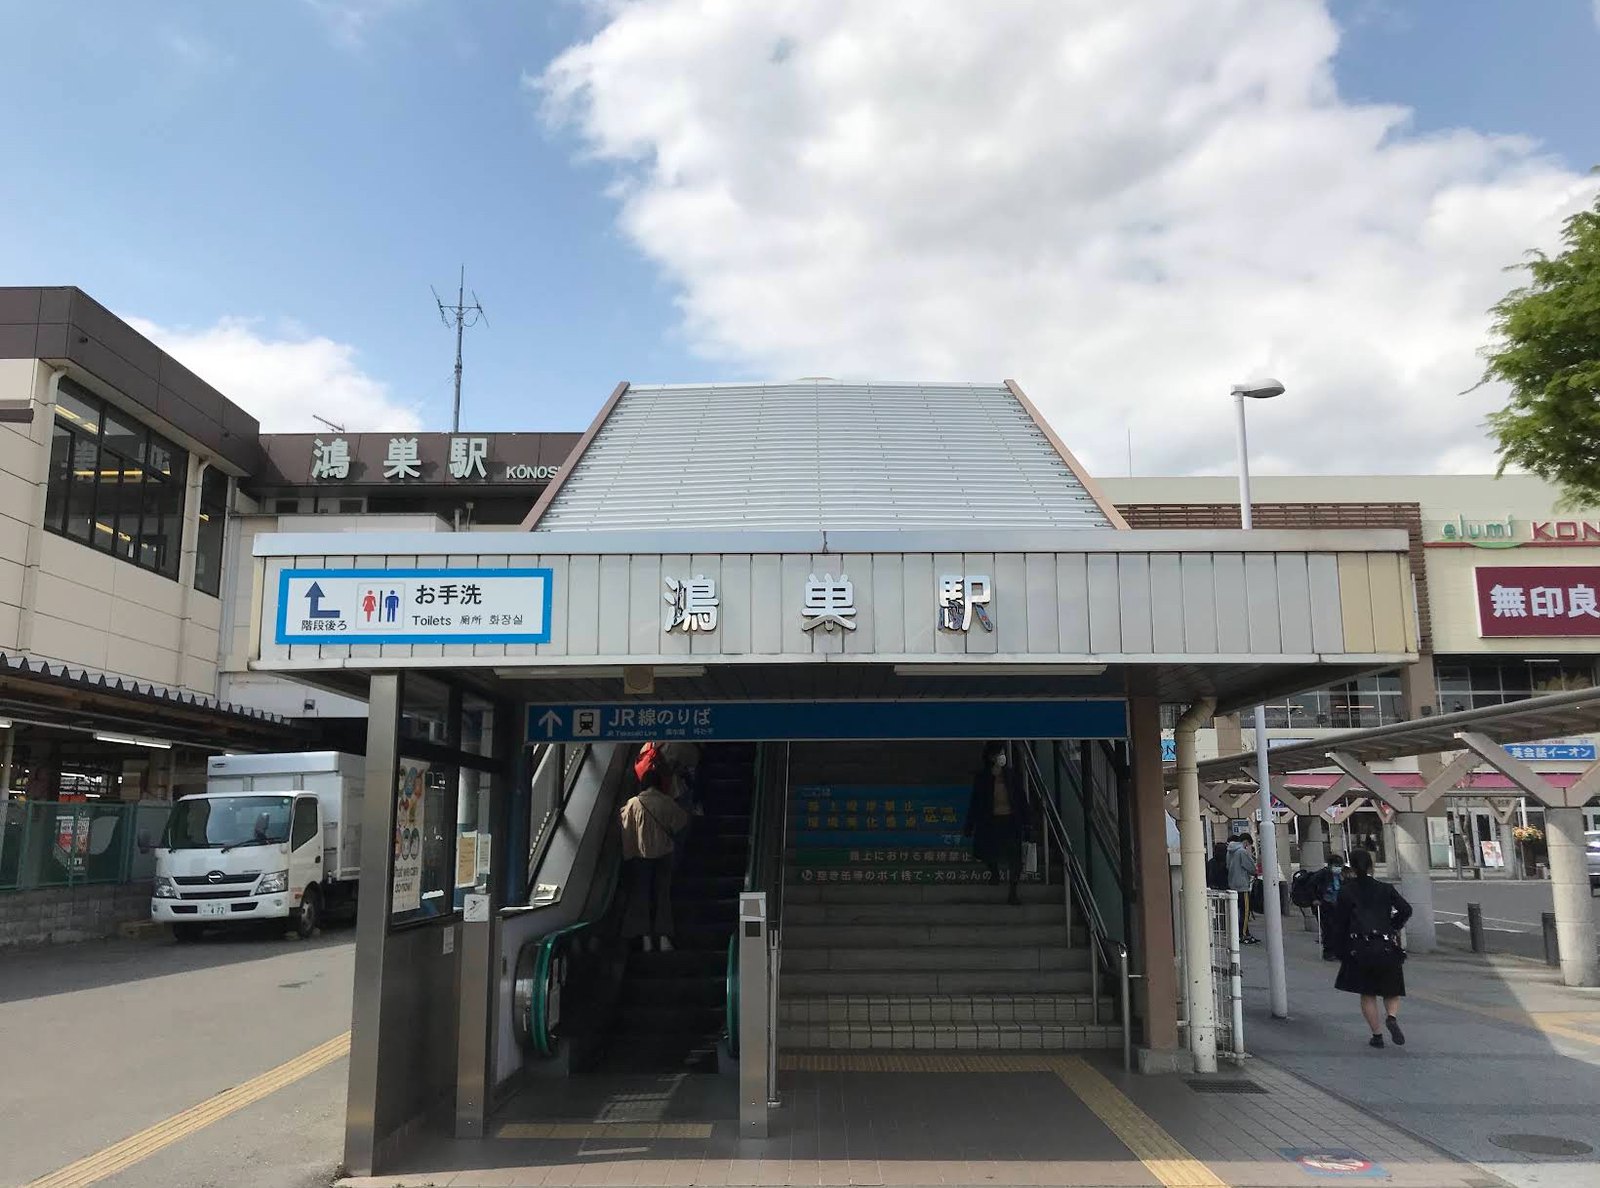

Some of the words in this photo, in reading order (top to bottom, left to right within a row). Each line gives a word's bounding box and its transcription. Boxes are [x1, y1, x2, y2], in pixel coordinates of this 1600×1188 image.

[311, 437, 488, 479] 鴻巣駅
[506, 464, 561, 479] KŌNOS
[1442, 514, 1513, 539] elumi
[415, 584, 482, 605] お手洗
[663, 573, 993, 632] 鴻巣駅
[1490, 584, 1600, 618] 無印良
[301, 619, 347, 631] 階段後ろ
[412, 615, 452, 626] Toilets
[489, 614, 524, 625] 화장실
[608, 707, 711, 727] JR線のりば
[1511, 747, 1591, 758] 英会話イーオン
